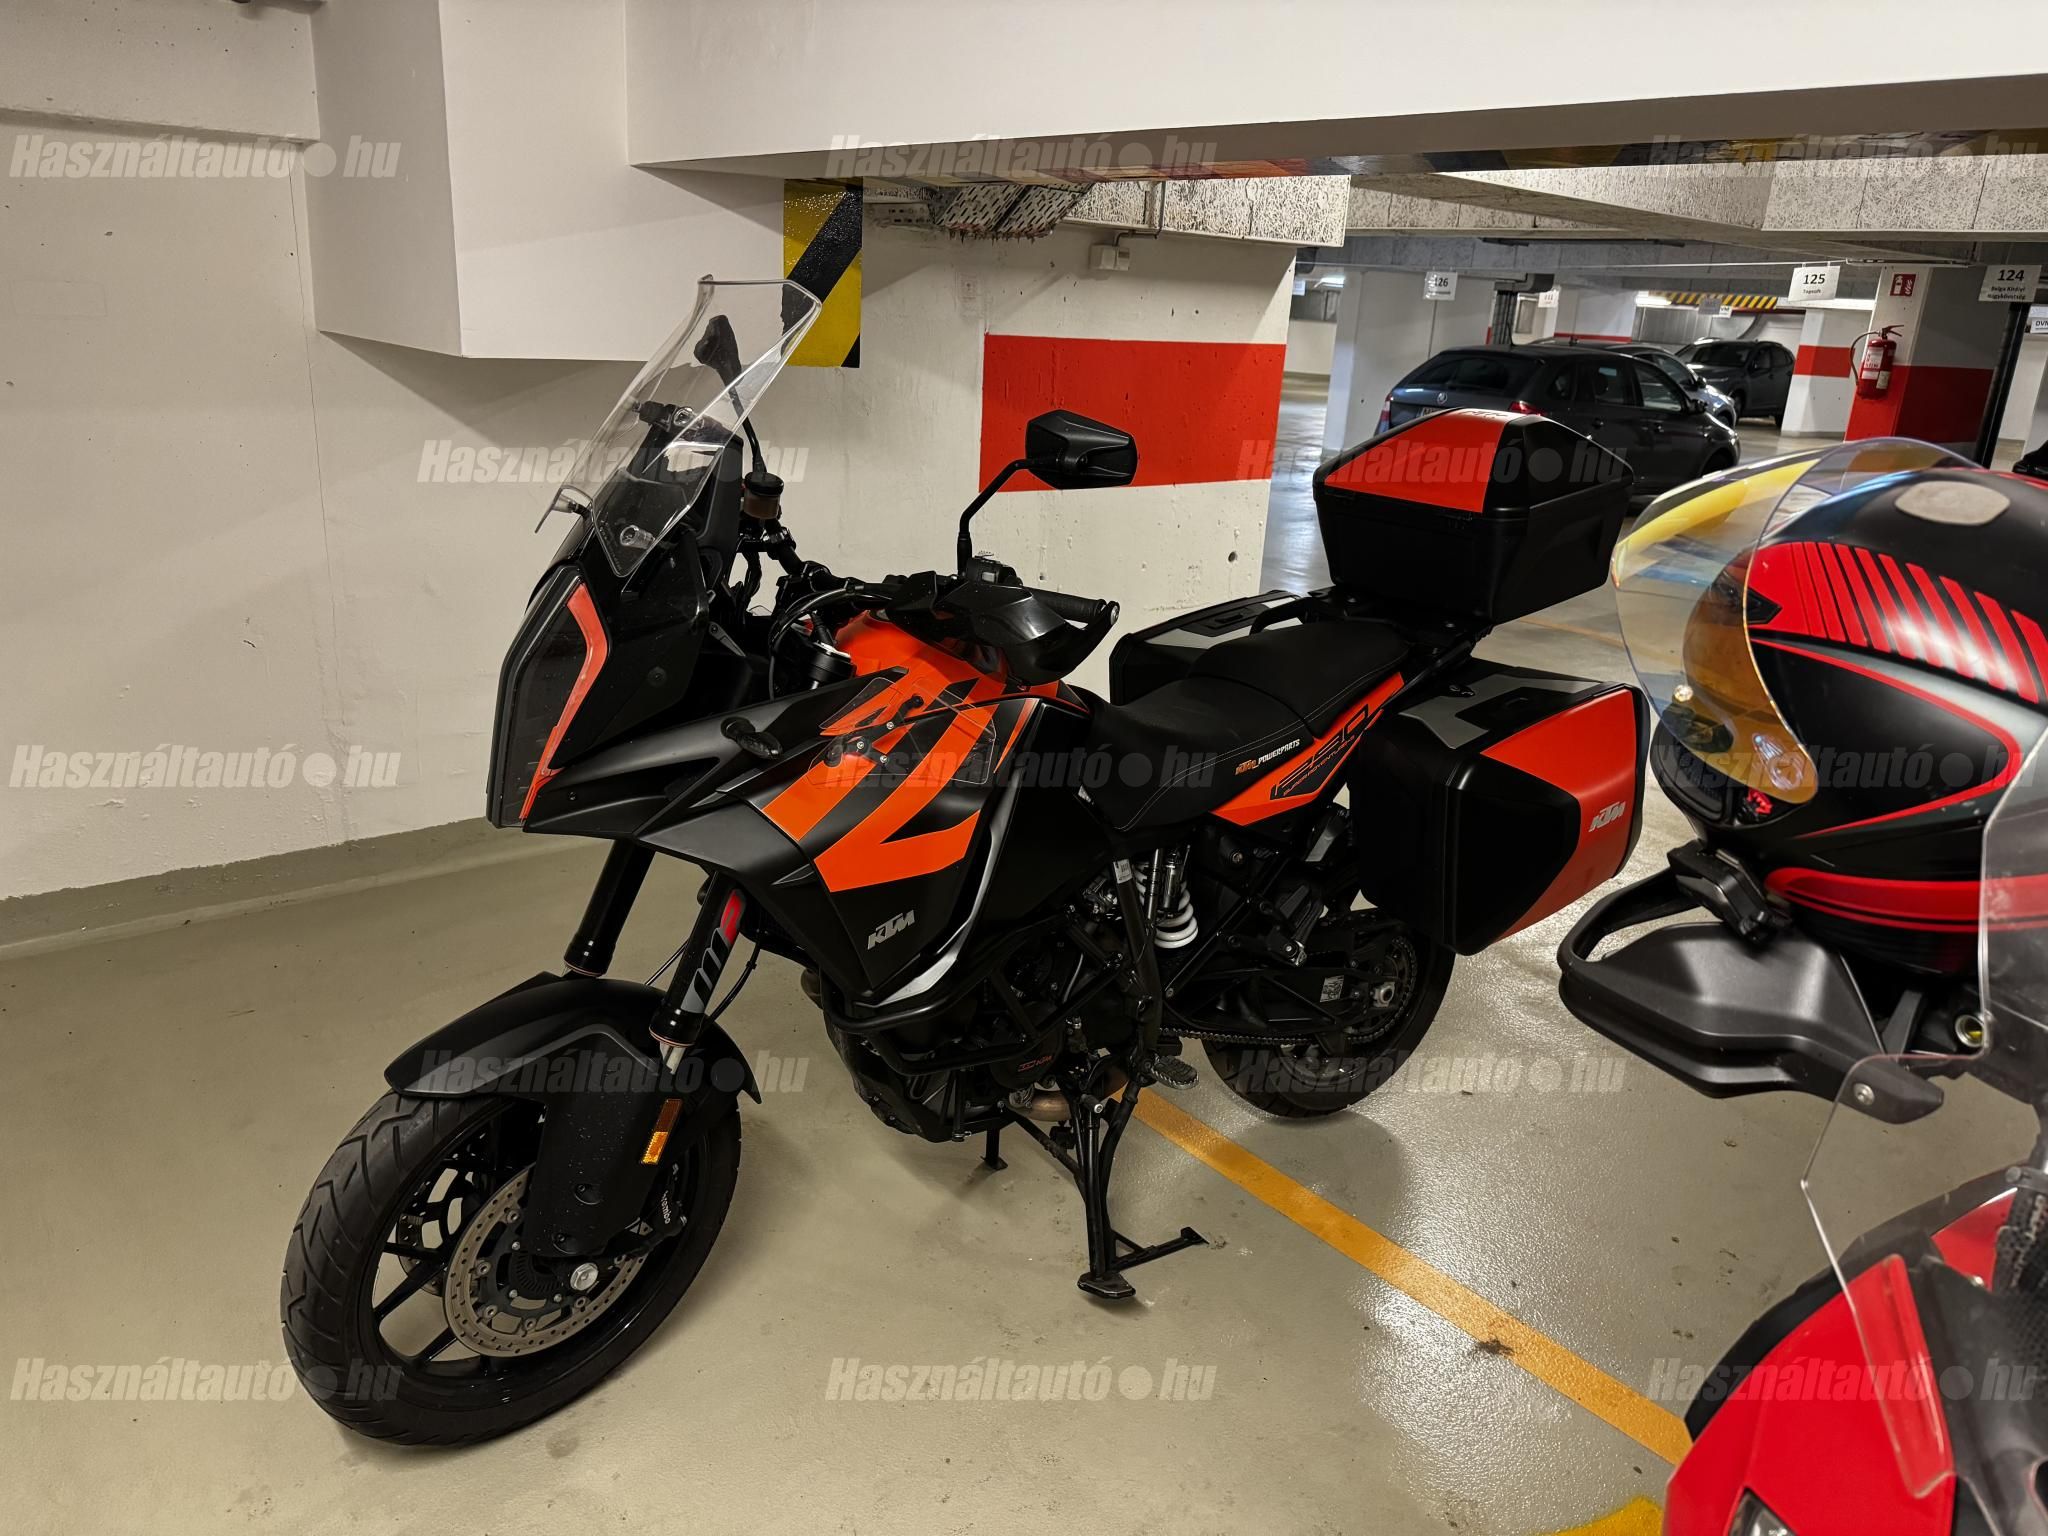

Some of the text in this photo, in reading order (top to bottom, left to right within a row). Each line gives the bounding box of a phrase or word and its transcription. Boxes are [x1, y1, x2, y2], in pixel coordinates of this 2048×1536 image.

[1433, 277, 1449, 287] 126
[1802, 273, 1826, 285] 125
[1997, 269, 2025, 281] 124
[1258, 738, 1301, 765] POWERPARTS
[1588, 800, 1626, 833] KTM
[867, 909, 915, 950] KTM
